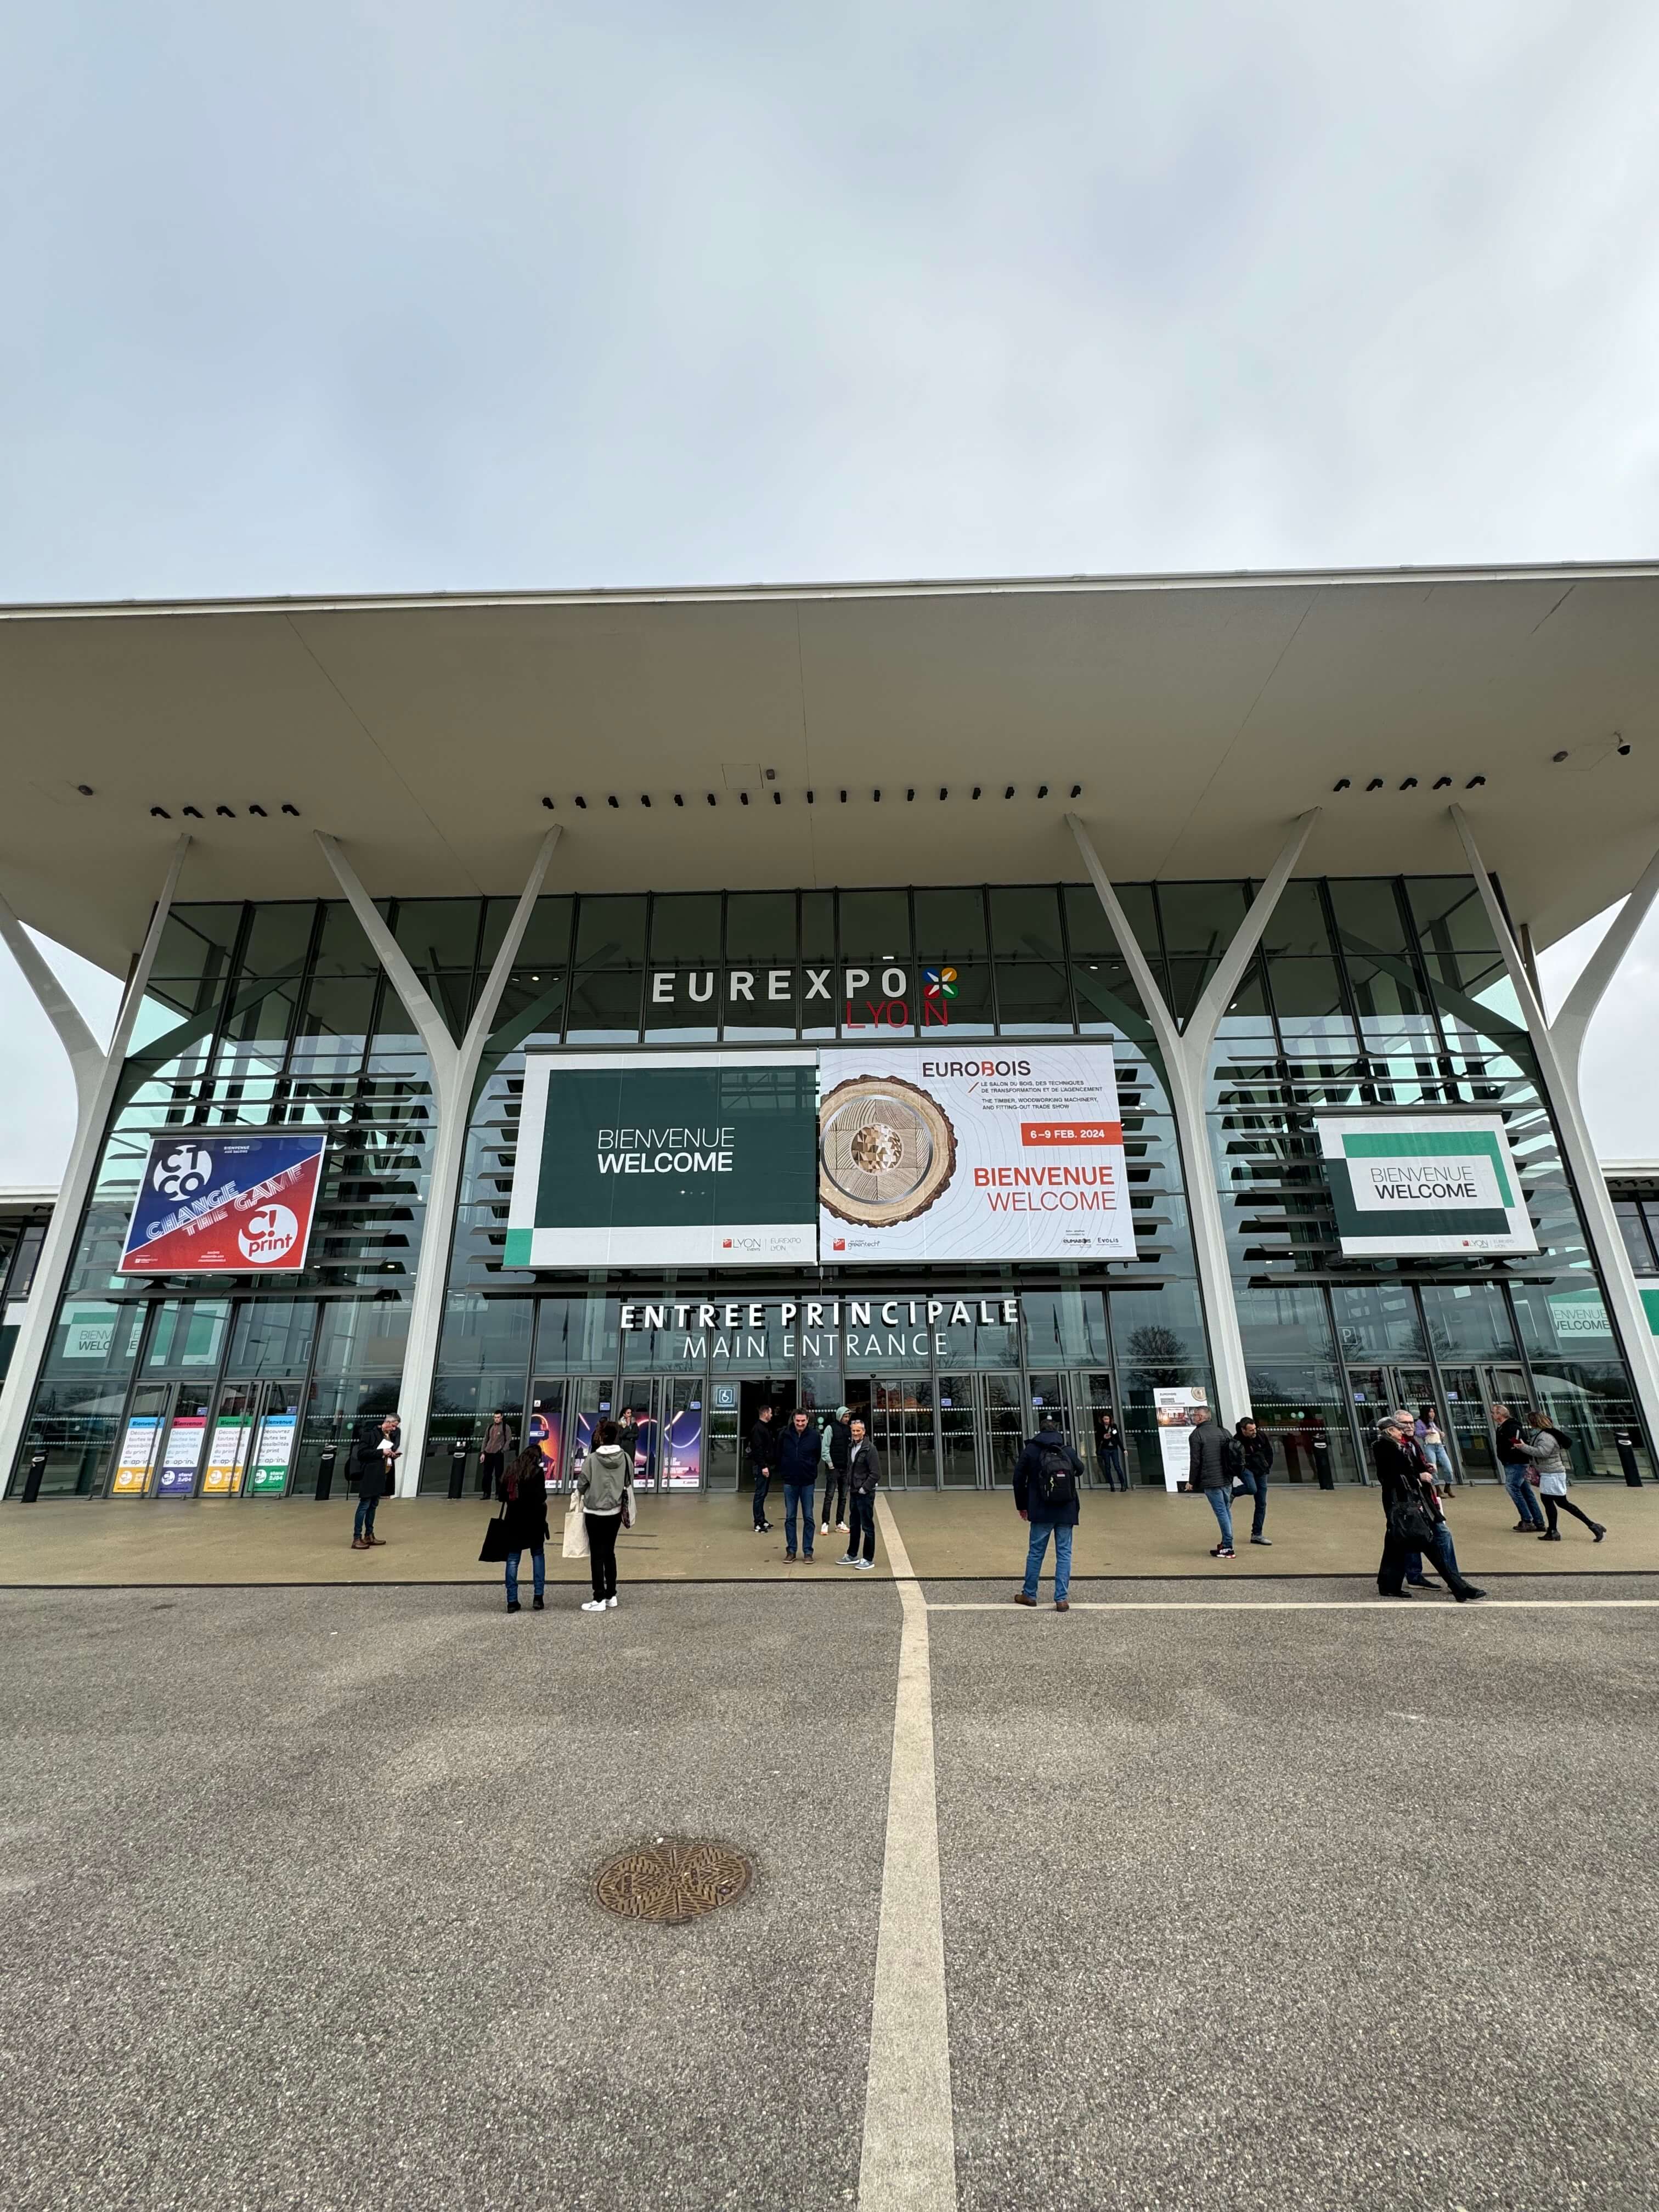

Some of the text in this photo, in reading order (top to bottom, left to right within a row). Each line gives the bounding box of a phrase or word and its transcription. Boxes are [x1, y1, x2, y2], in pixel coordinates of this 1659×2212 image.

[652, 968, 908, 1003] EUREXPO
[845, 999, 948, 1029] LYON
[922, 1060, 1031, 1077] EUROBOIS
[597, 1127, 735, 1149] BIENVENUE
[1054, 1129, 1077, 1139] FEB.
[1080, 1129, 1105, 1138] 2024
[597, 1152, 733, 1173] WELCOME
[974, 1166, 1115, 1187] BIENVENUE
[1370, 1166, 1475, 1183] BIENVENUE
[182, 1164, 305, 1236] THE GAME
[988, 1190, 1117, 1211] WELCOME
[1374, 1183, 1477, 1199] WELCOME
[146, 1180, 239, 1239] CHANGE
[249, 1233, 292, 1257] print
[733, 1238, 761, 1248] LYON
[620, 1300, 1019, 1328] ENTREE PRINCIPALE
[1554, 1309, 1607, 1319] ENVENUE
[682, 1333, 947, 1358] MAIN ENTRANCE
